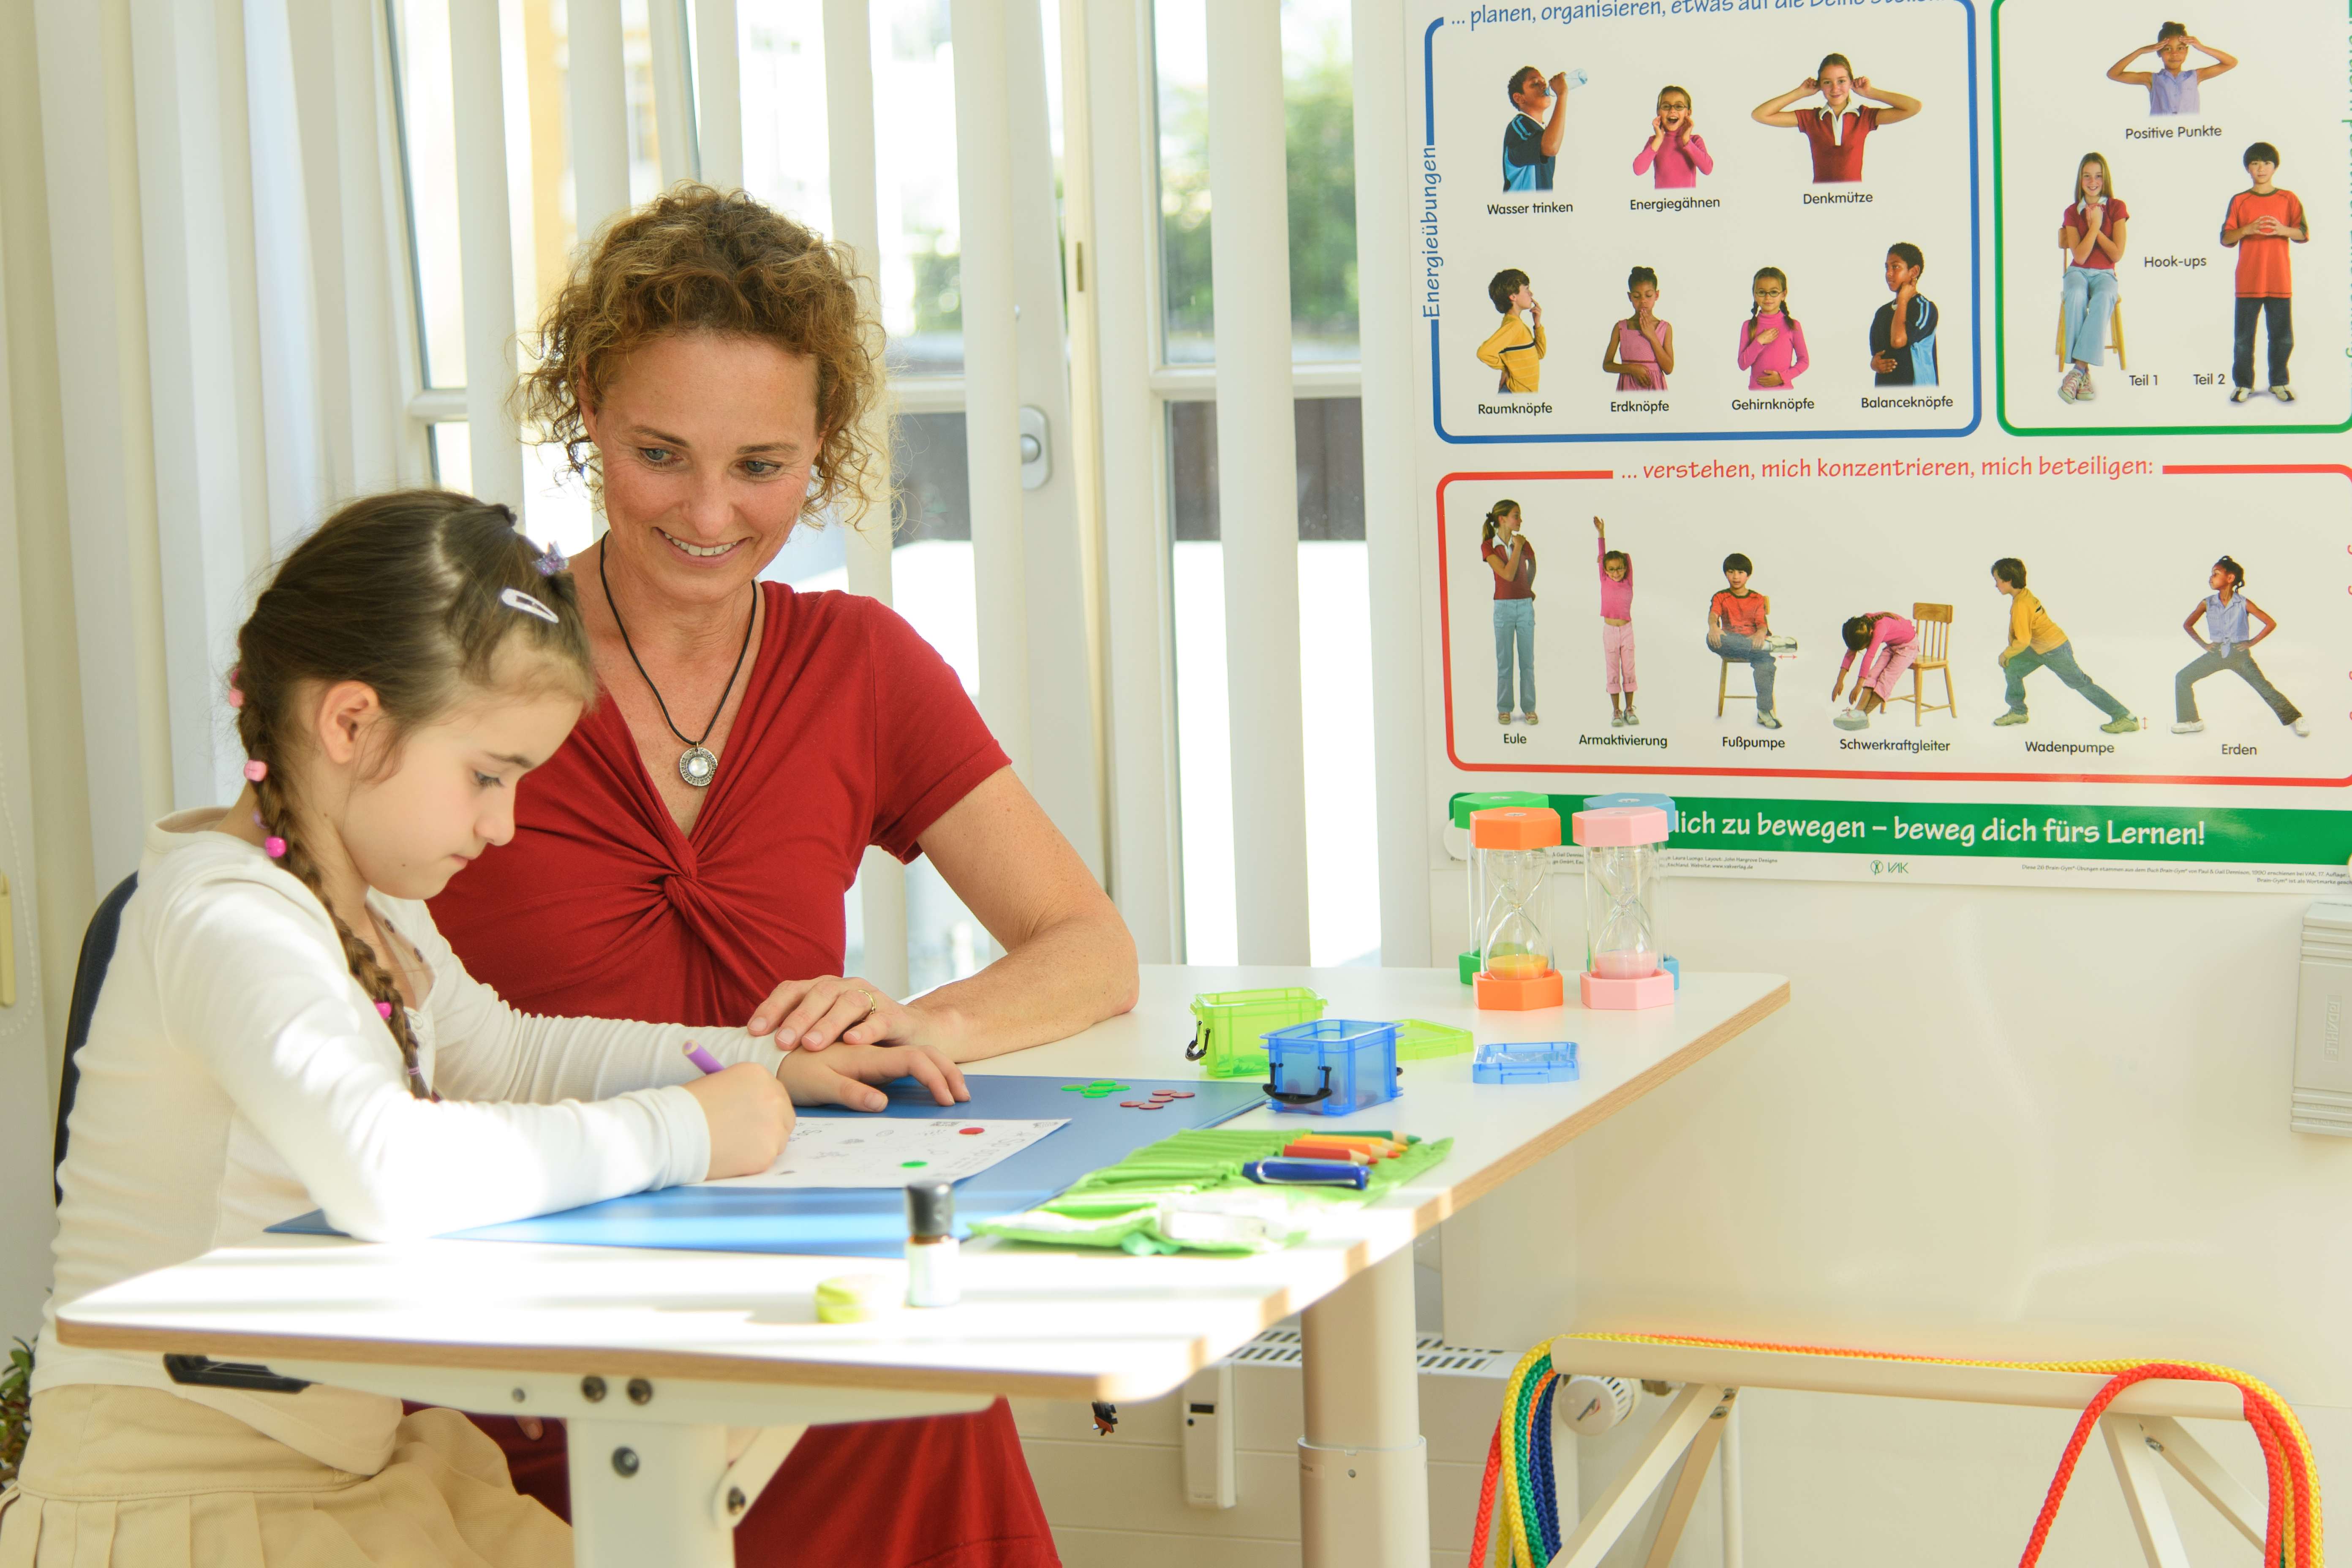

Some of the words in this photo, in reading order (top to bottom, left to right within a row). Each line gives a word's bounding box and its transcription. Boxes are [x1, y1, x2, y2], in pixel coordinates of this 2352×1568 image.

[1471, 4, 1536, 31] planen,
[1541, 0, 1666, 24] organisieren,
[1671, 0, 1734, 14] etwas
[2126, 127, 2173, 139] Positive
[2178, 125, 2222, 137] Punkte
[1630, 196, 1720, 212] Energiegähnen
[1803, 192, 1873, 204] Denkmütze
[1487, 204, 1530, 215] Wasser
[1532, 201, 1573, 213] trinken
[1420, 145, 1444, 318] Energieübungen
[2144, 255, 2207, 270] Hook-ups
[2129, 374, 2149, 386] Teil
[2153, 375, 2158, 386] 1
[2193, 373, 2213, 385] Teil
[2218, 373, 2225, 385] 2
[1478, 402, 1552, 416] Raumknöpfe
[1611, 400, 1669, 414] Erdknöpfe
[1731, 397, 1815, 412] Gehirnknöpfe
[1861, 395, 1953, 410] Balanceknöpfe
[1643, 459, 1755, 480] verstehen,
[1762, 458, 1811, 477] mich
[1818, 457, 1975, 478] konzentrieren,
[1982, 456, 2032, 475] mich
[2039, 455, 2153, 480] beteiligen:
[1503, 733, 1527, 744] Eule
[1579, 734, 1668, 749] Armaktivierung
[1723, 736, 1786, 751] Fußpumpe
[1840, 738, 1951, 754] Schwerkraftgleiter
[2025, 741, 2115, 756] Wadenpumpe
[2222, 743, 2258, 755] Erden
[1722, 818, 1750, 835] zu
[1757, 812, 1865, 844] bewegen
[1894, 816, 1975, 847] beweg
[1982, 817, 2036, 841] dich
[2042, 818, 2100, 843] fürs
[2107, 819, 2205, 845] Lernen!
